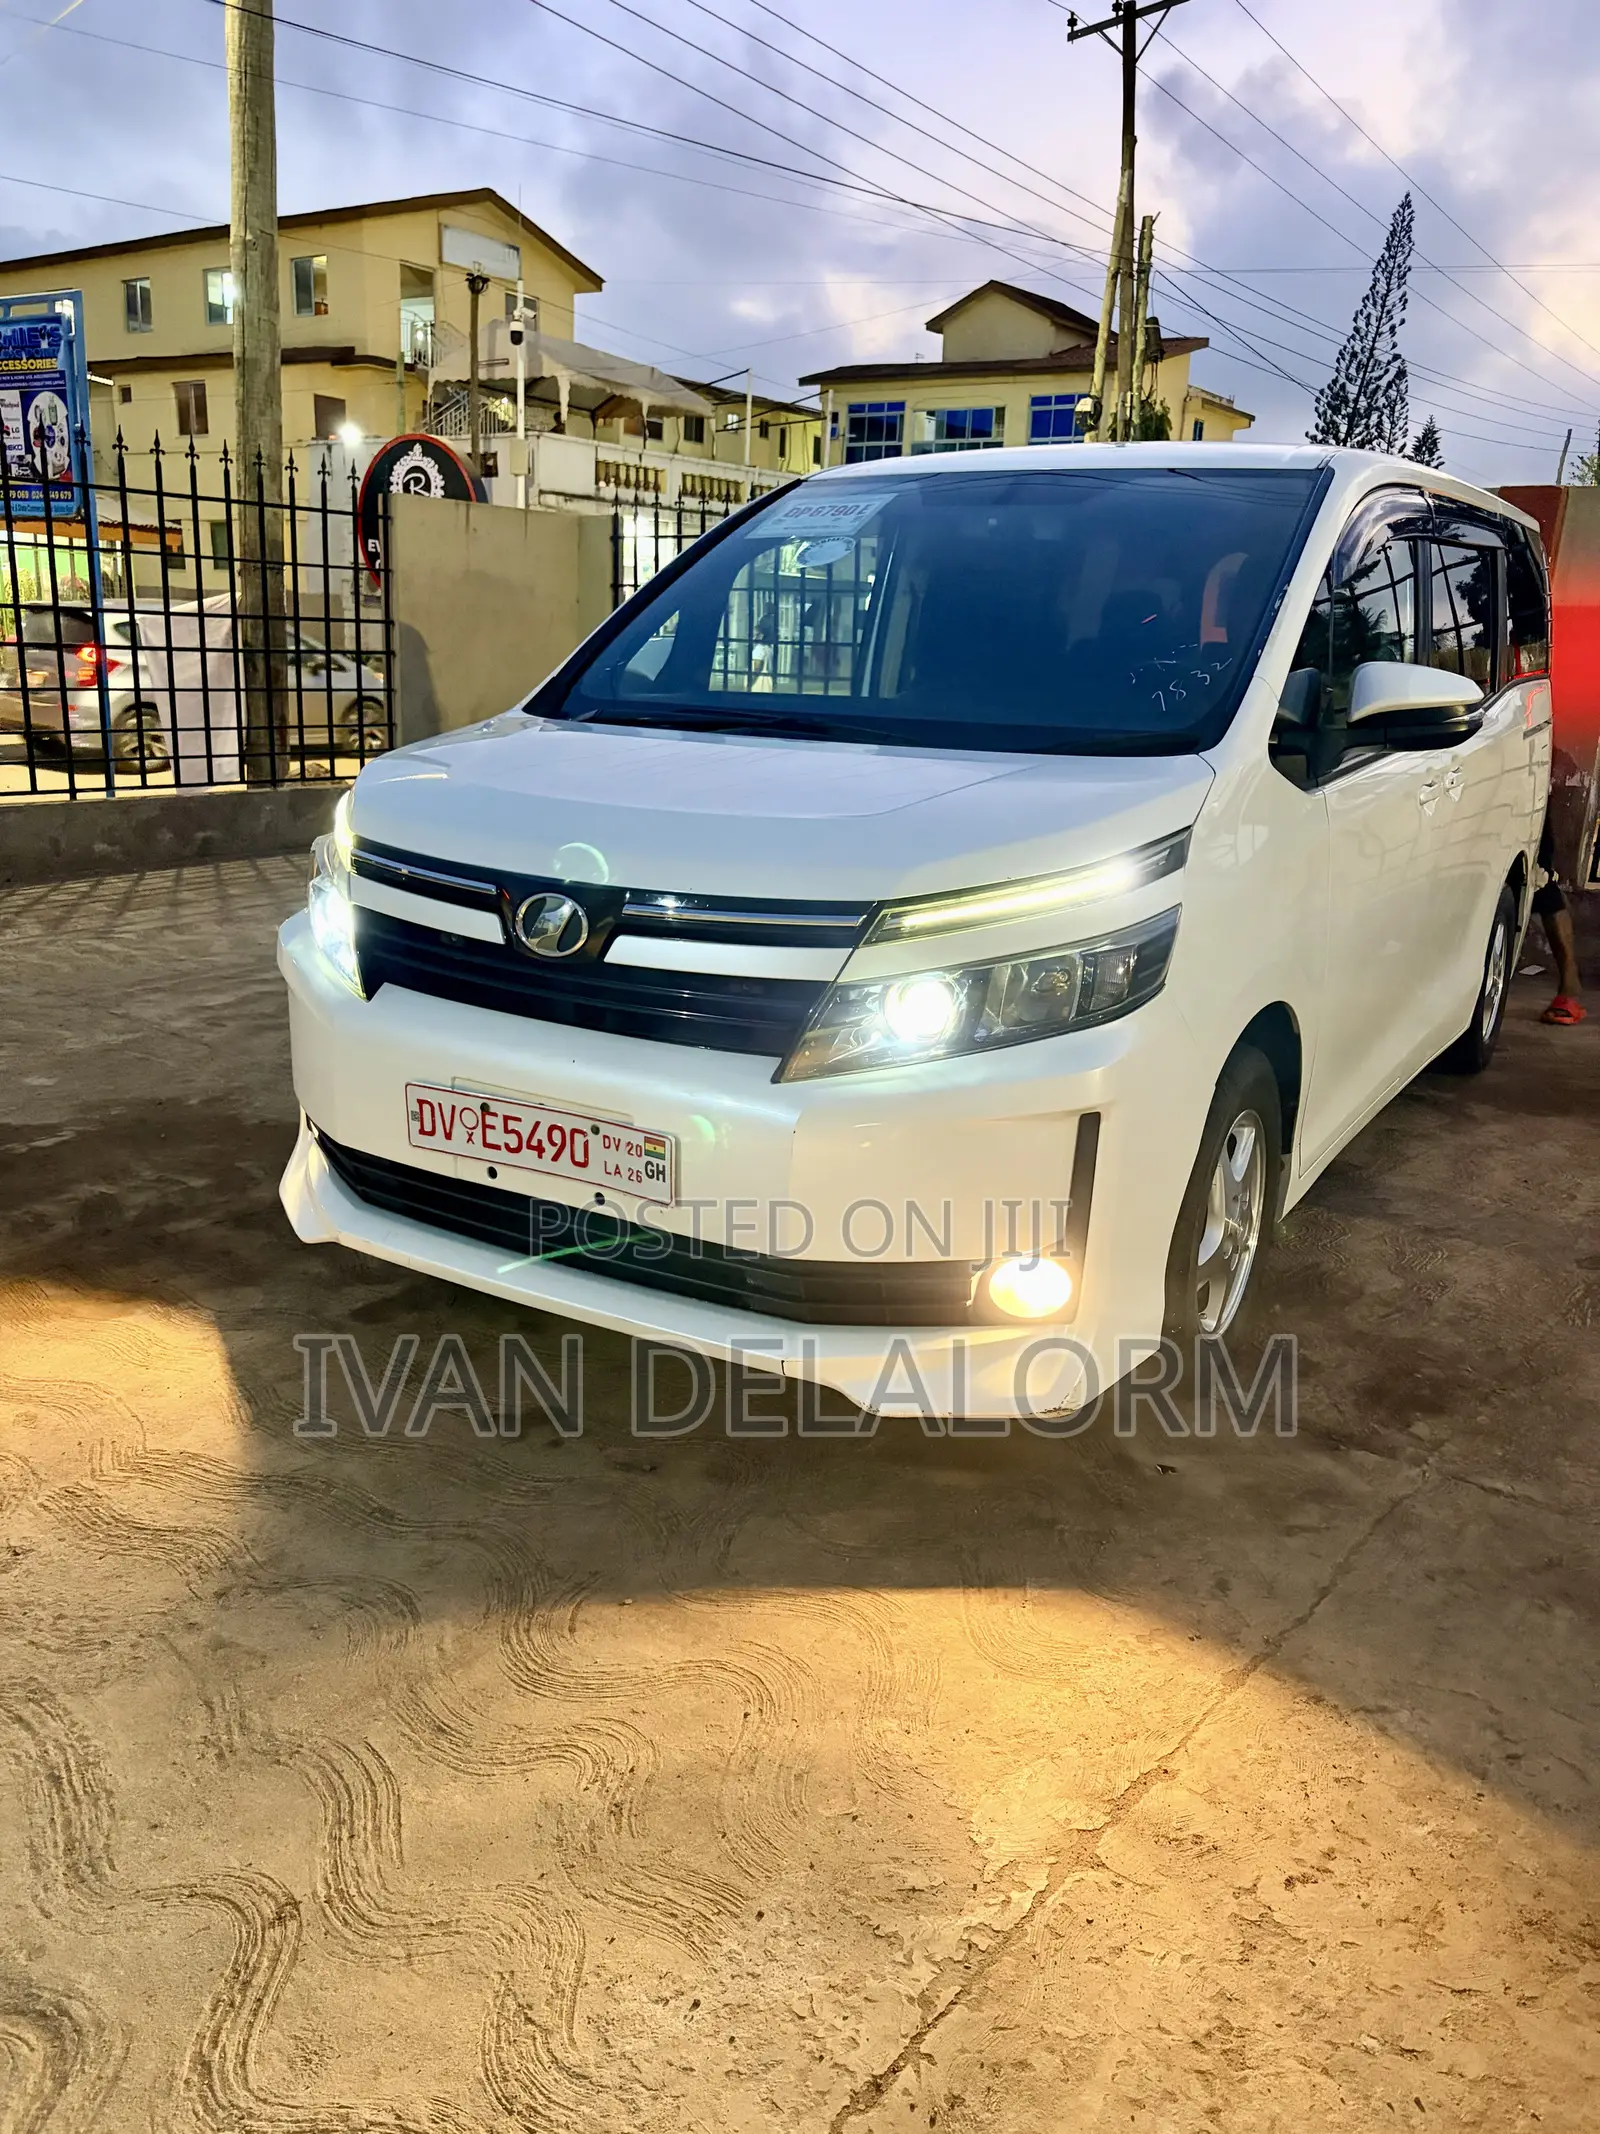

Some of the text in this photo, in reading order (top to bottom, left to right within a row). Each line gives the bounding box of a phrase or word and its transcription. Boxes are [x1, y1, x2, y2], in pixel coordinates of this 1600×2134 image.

[602, 1134, 643, 1158] DV 20
[604, 1160, 643, 1183] LA 26
[644, 1160, 667, 1183] GH
